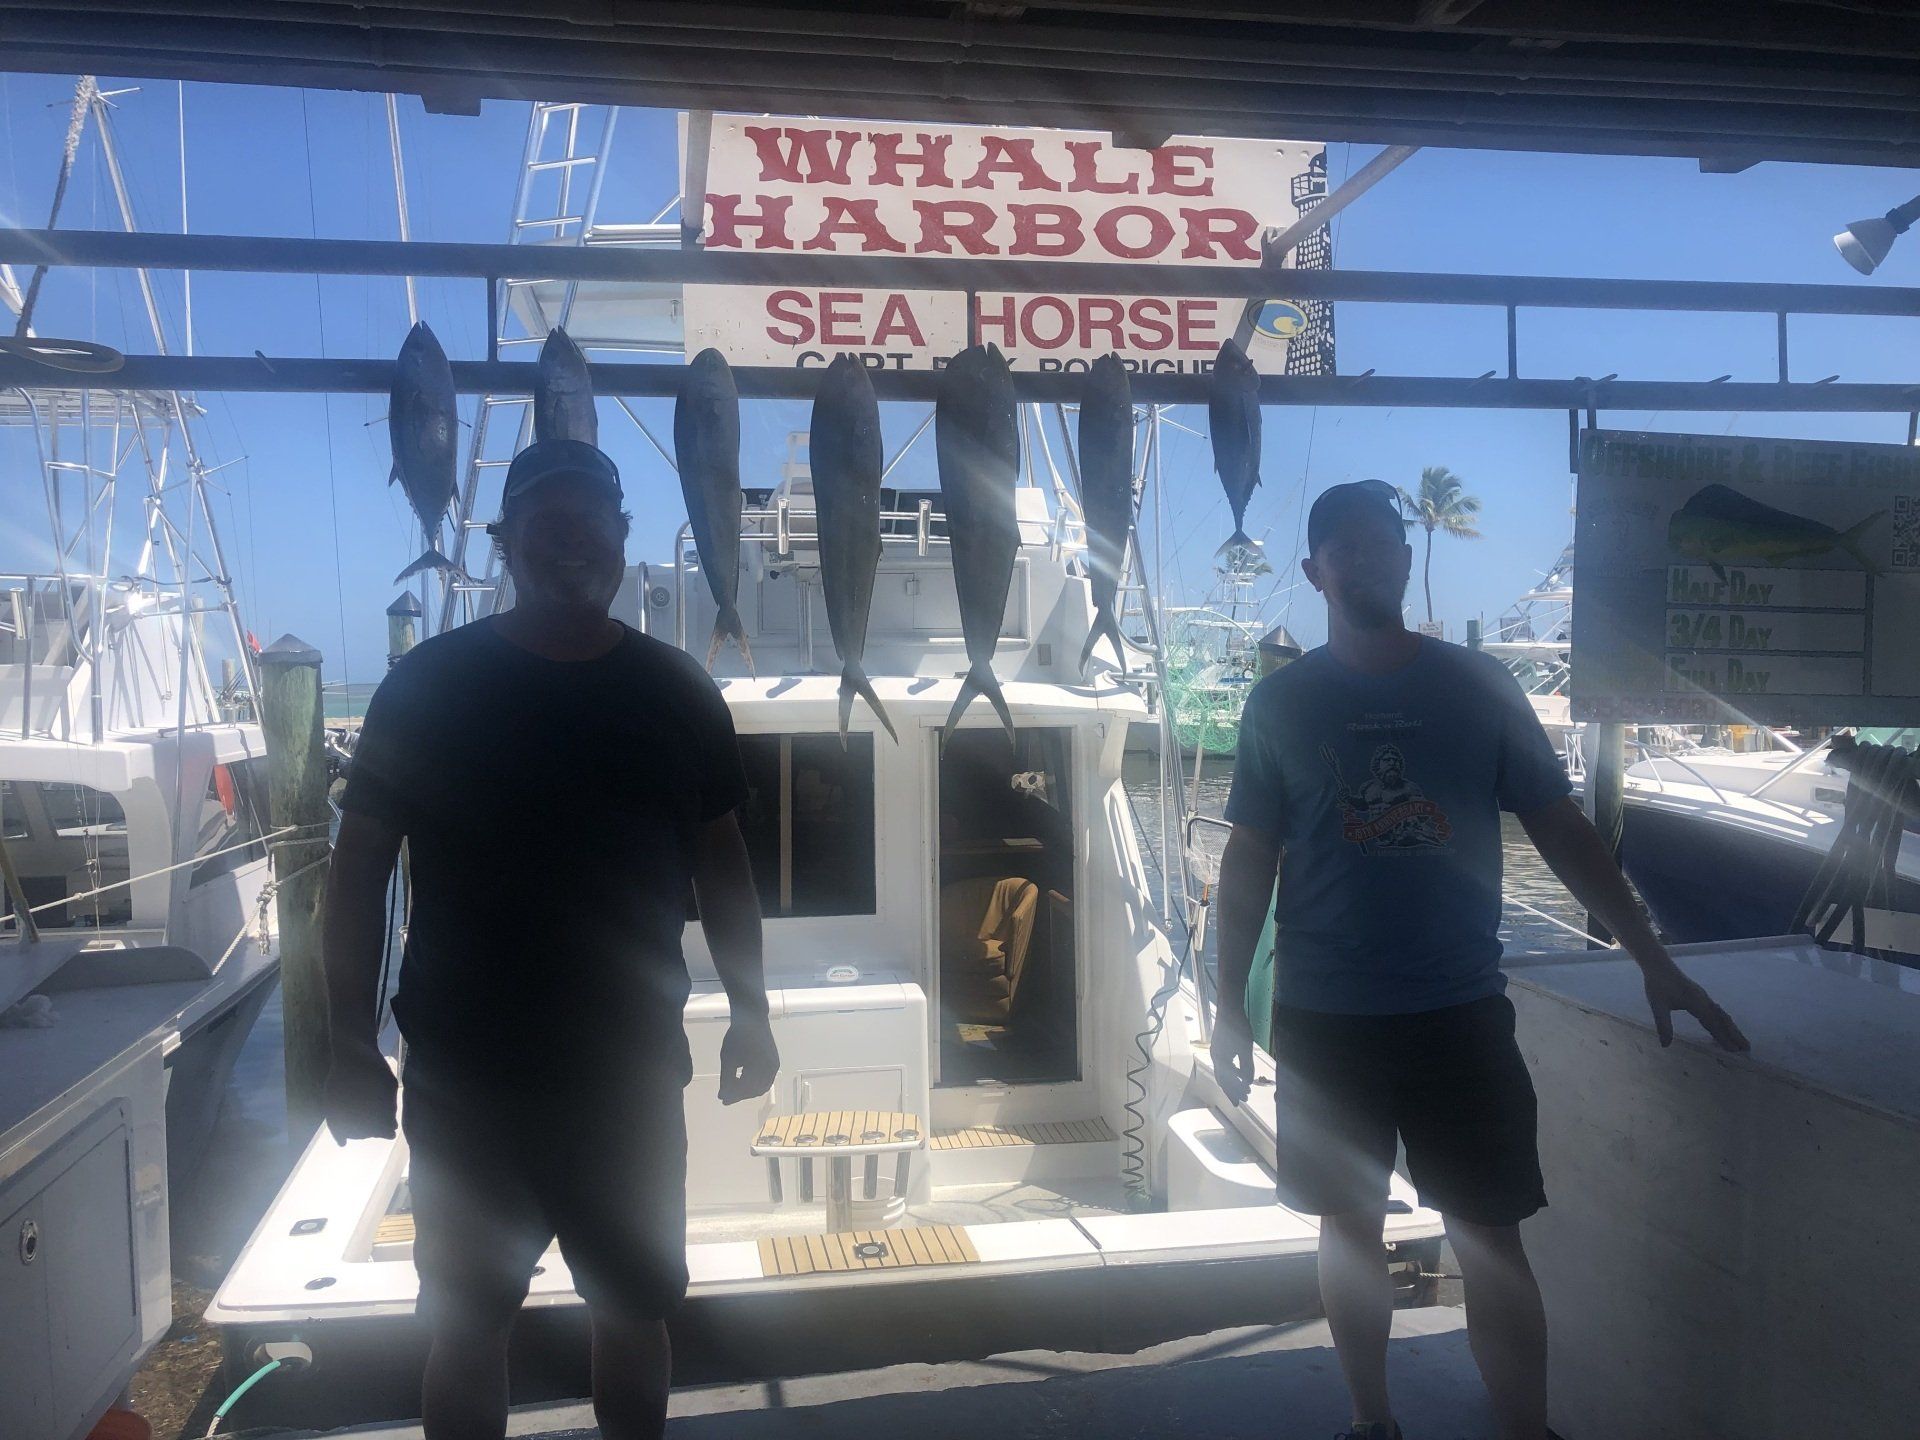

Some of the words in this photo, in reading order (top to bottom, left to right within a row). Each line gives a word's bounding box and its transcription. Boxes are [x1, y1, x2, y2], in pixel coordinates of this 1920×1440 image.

[744, 126, 1214, 196] WHALE
[704, 193, 1262, 260] HARBOR
[765, 290, 926, 347] SEA
[974, 296, 1220, 351] HORSE
[1670, 613, 1722, 649] 3/4
